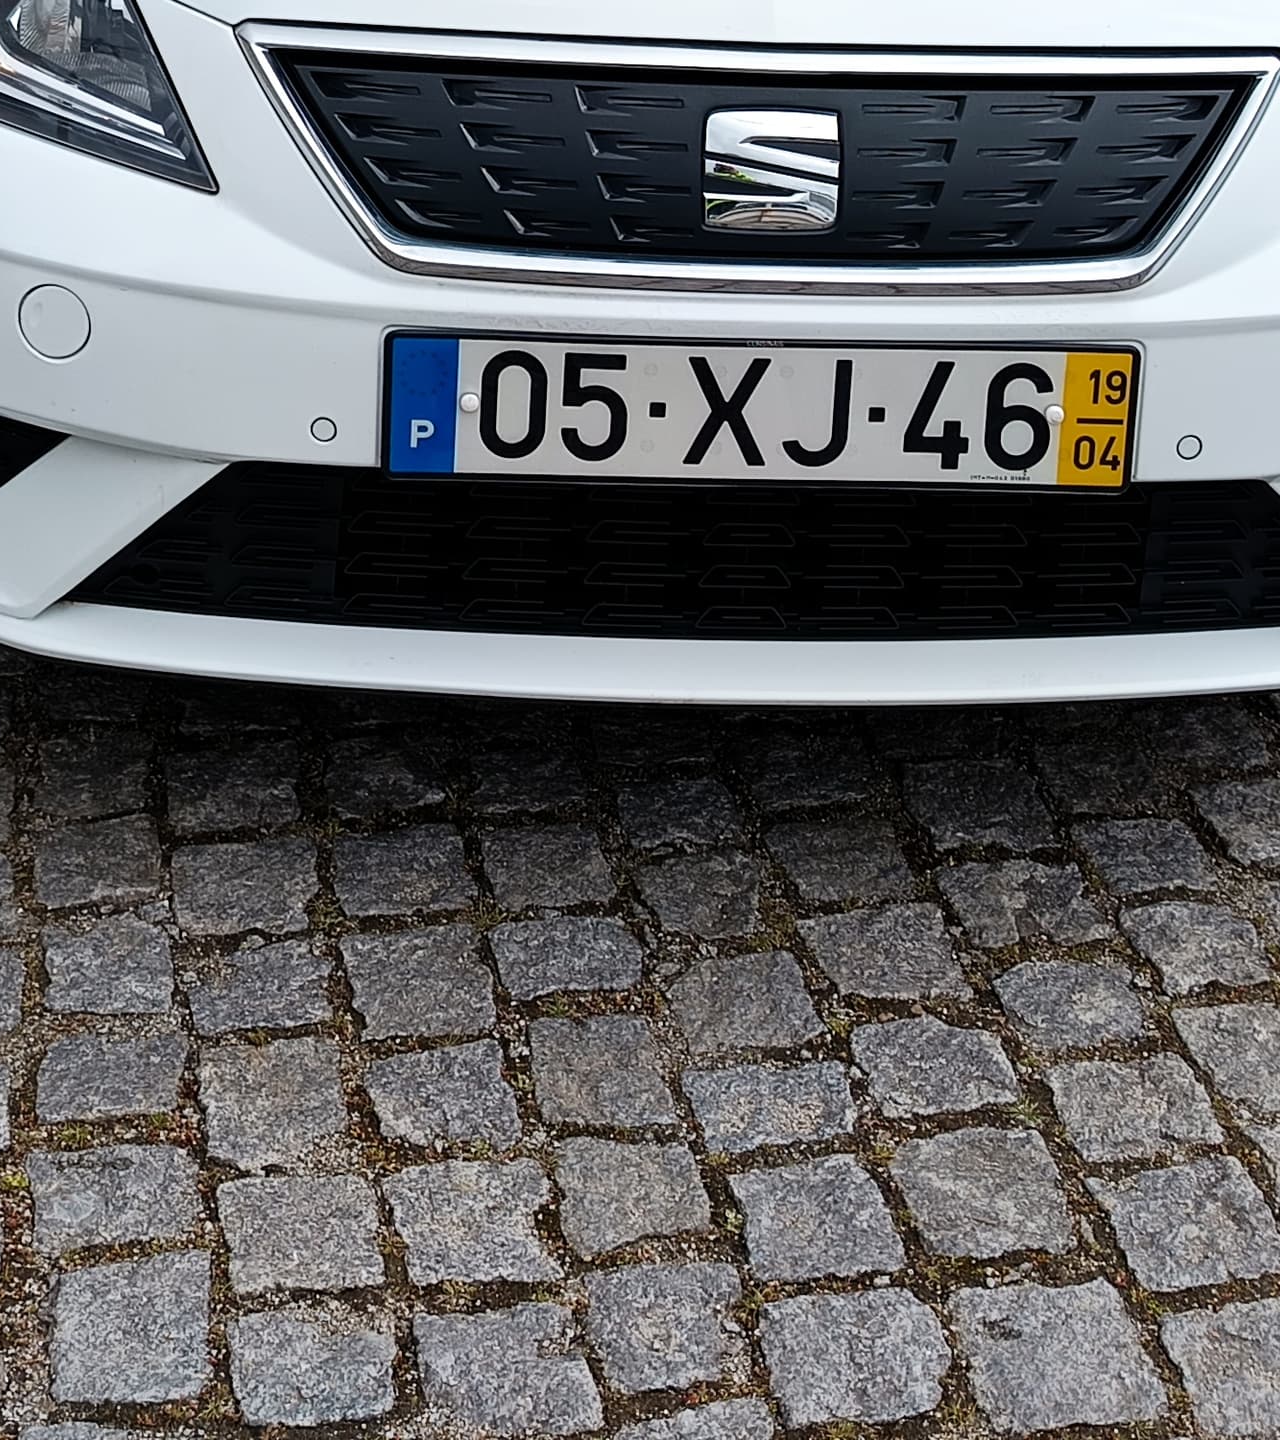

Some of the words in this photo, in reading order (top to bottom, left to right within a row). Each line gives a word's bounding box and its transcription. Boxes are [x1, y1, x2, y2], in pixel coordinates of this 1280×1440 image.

[1089, 368, 1128, 405] 19
[409, 418, 436, 449] P
[1072, 435, 1121, 471] 04
